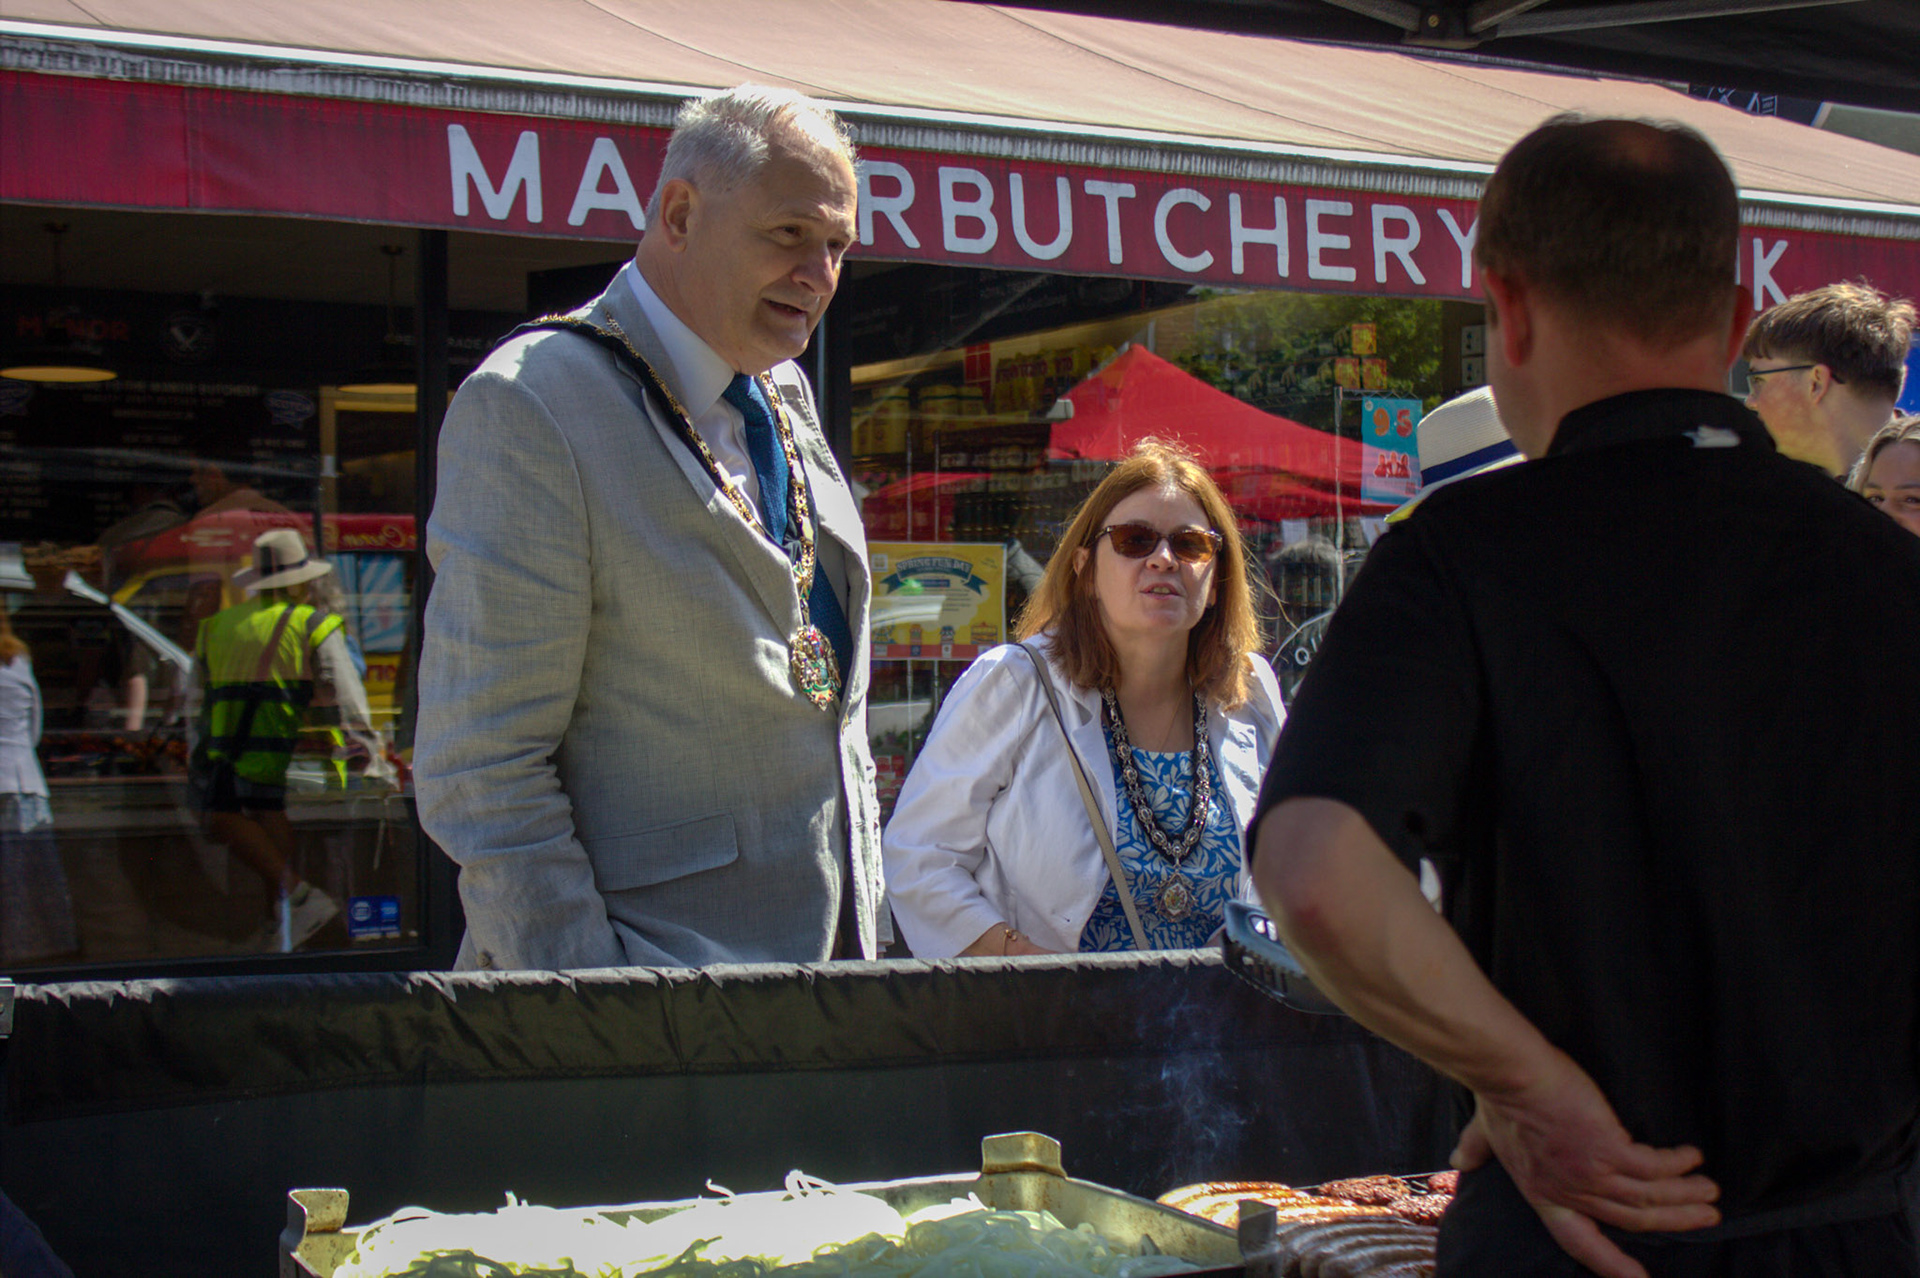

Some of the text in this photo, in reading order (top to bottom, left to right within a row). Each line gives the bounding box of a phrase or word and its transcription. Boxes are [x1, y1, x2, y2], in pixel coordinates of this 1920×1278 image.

[896, 557, 931, 572] SPRING
[931, 557, 952, 569] FUN
[953, 558, 972, 574] DAY
